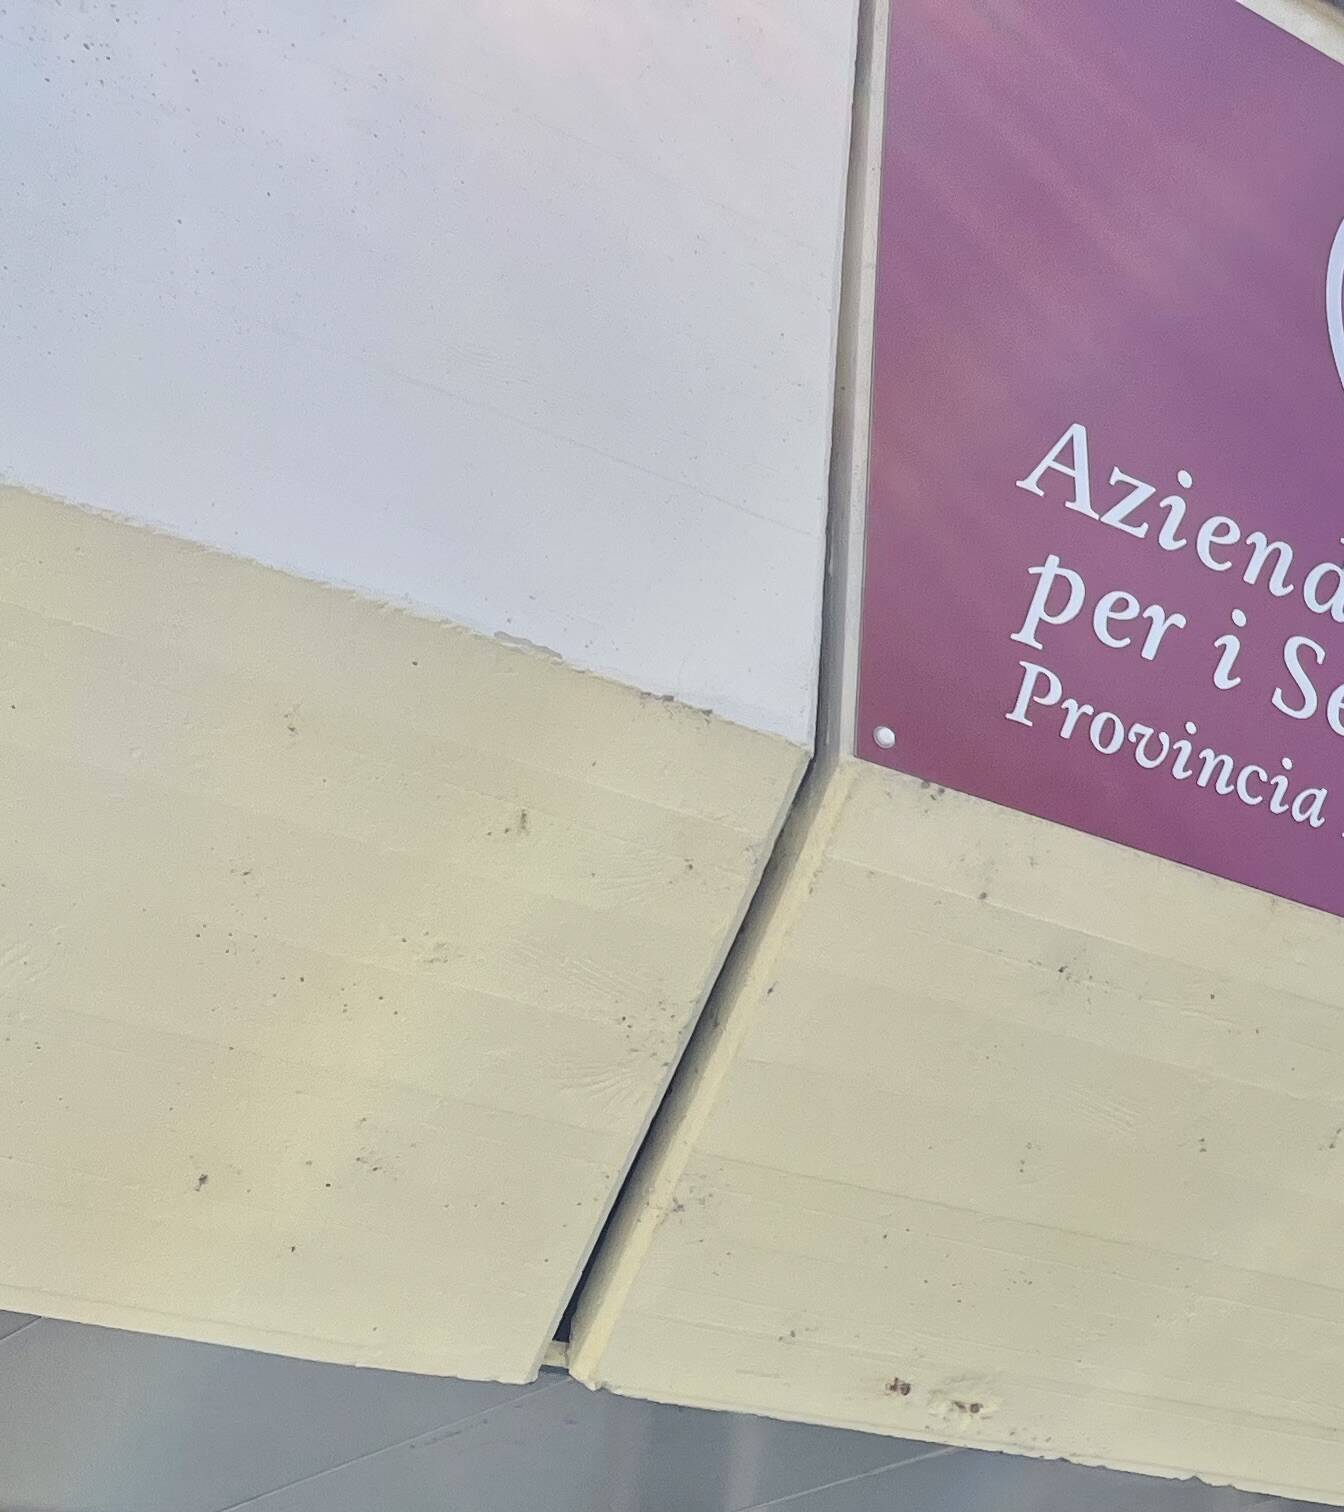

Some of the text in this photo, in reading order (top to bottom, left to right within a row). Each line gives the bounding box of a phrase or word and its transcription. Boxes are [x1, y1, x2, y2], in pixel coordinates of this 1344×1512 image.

[1010, 554, 1187, 661] per
[1213, 608, 1247, 690] i
[1005, 660, 1328, 828] Provincia
